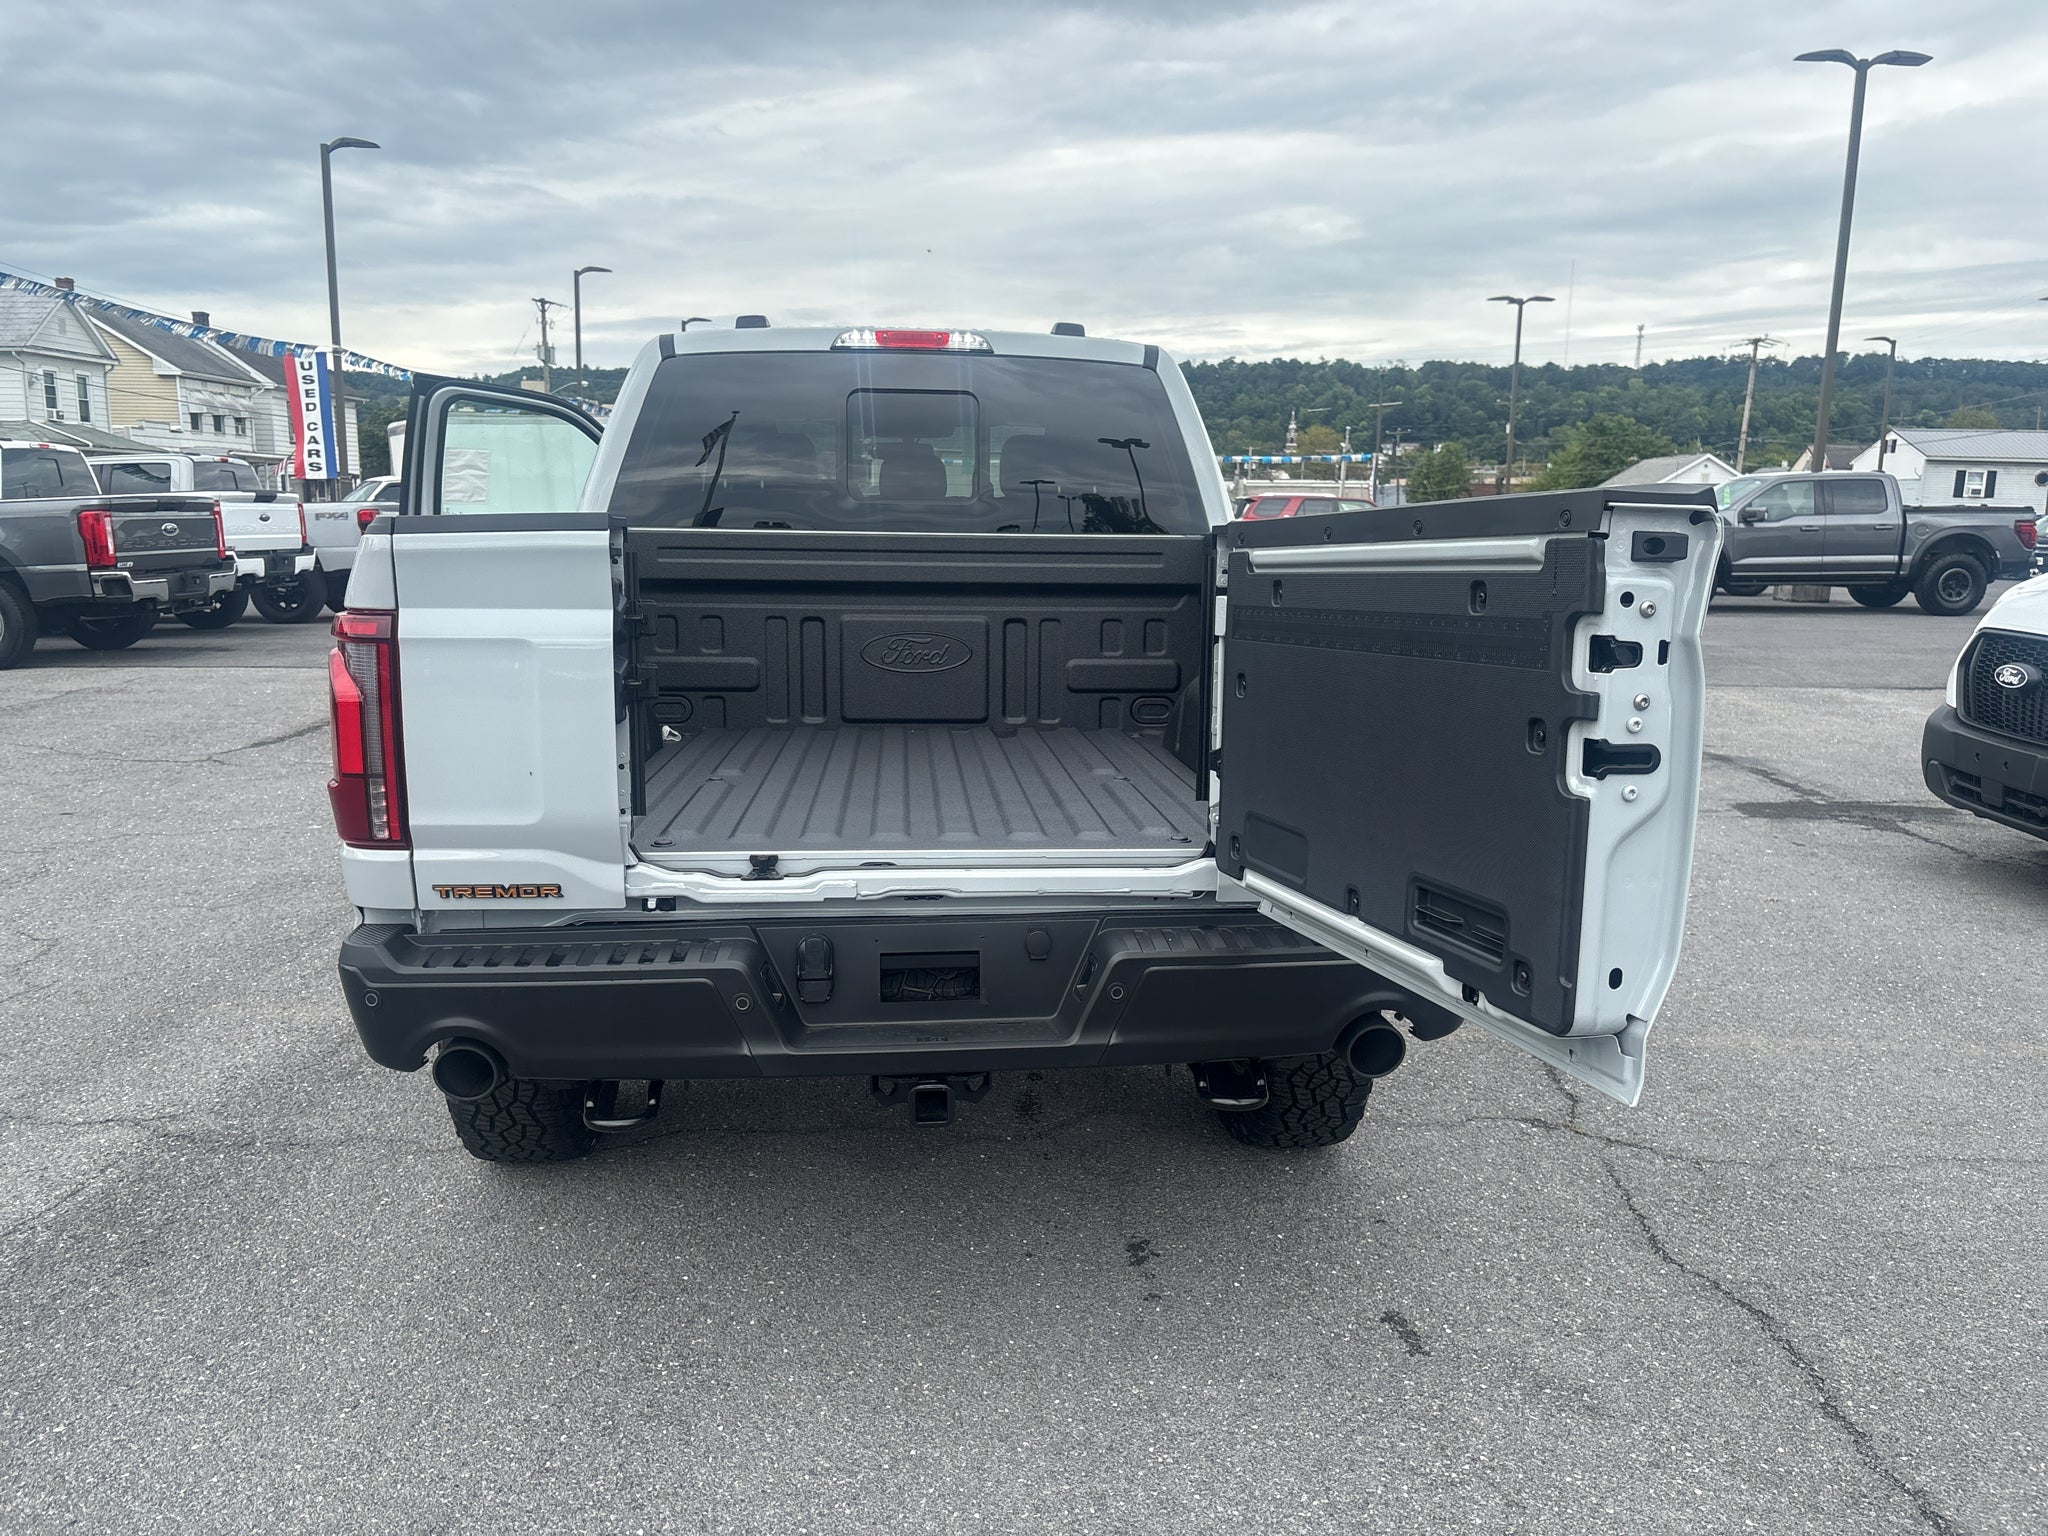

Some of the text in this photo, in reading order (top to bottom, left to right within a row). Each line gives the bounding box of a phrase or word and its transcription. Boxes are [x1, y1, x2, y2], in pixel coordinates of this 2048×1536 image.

[300, 361, 322, 472] USED CARS
[315, 512, 348, 520] FX4
[123, 538, 215, 548] SUPER DUTY
[882, 637, 949, 665] Ford
[1999, 668, 2021, 684] Ford
[432, 884, 564, 898] TREMOR
